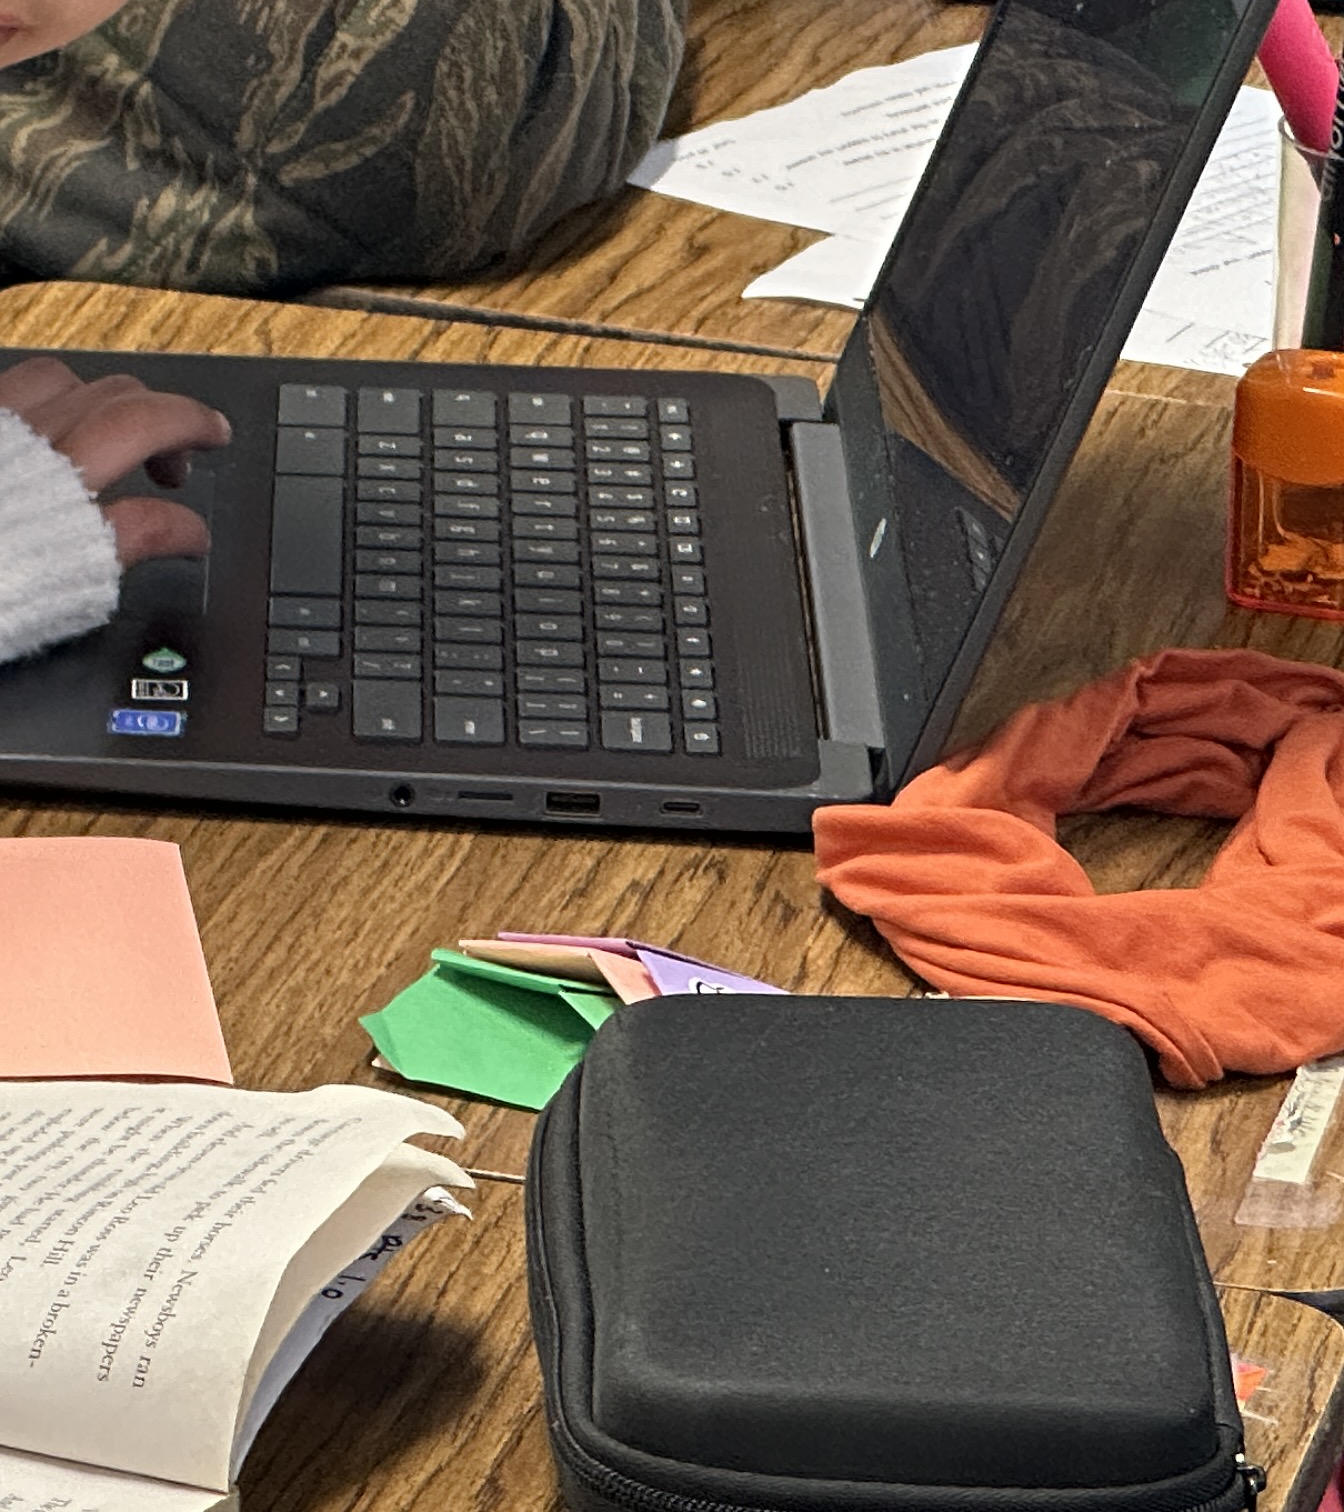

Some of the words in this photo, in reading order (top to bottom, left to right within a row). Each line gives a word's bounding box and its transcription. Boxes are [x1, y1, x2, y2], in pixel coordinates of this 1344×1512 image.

[120, 1195, 152, 1214] Leo
[164, 1226, 186, 1242] up
[187, 1222, 232, 1263] horses.
[40, 1240, 75, 1267] Hill.
[76, 1245, 100, 1267] was
[143, 1248, 174, 1281] their
[64, 1272, 87, 1285] in
[57, 1290, 69, 1298] a
[144, 1270, 198, 1348] Newsboys
[29, 1303, 70, 1367] broken-
[97, 1288, 147, 1381] newspapers
[133, 1356, 151, 1387] ran
